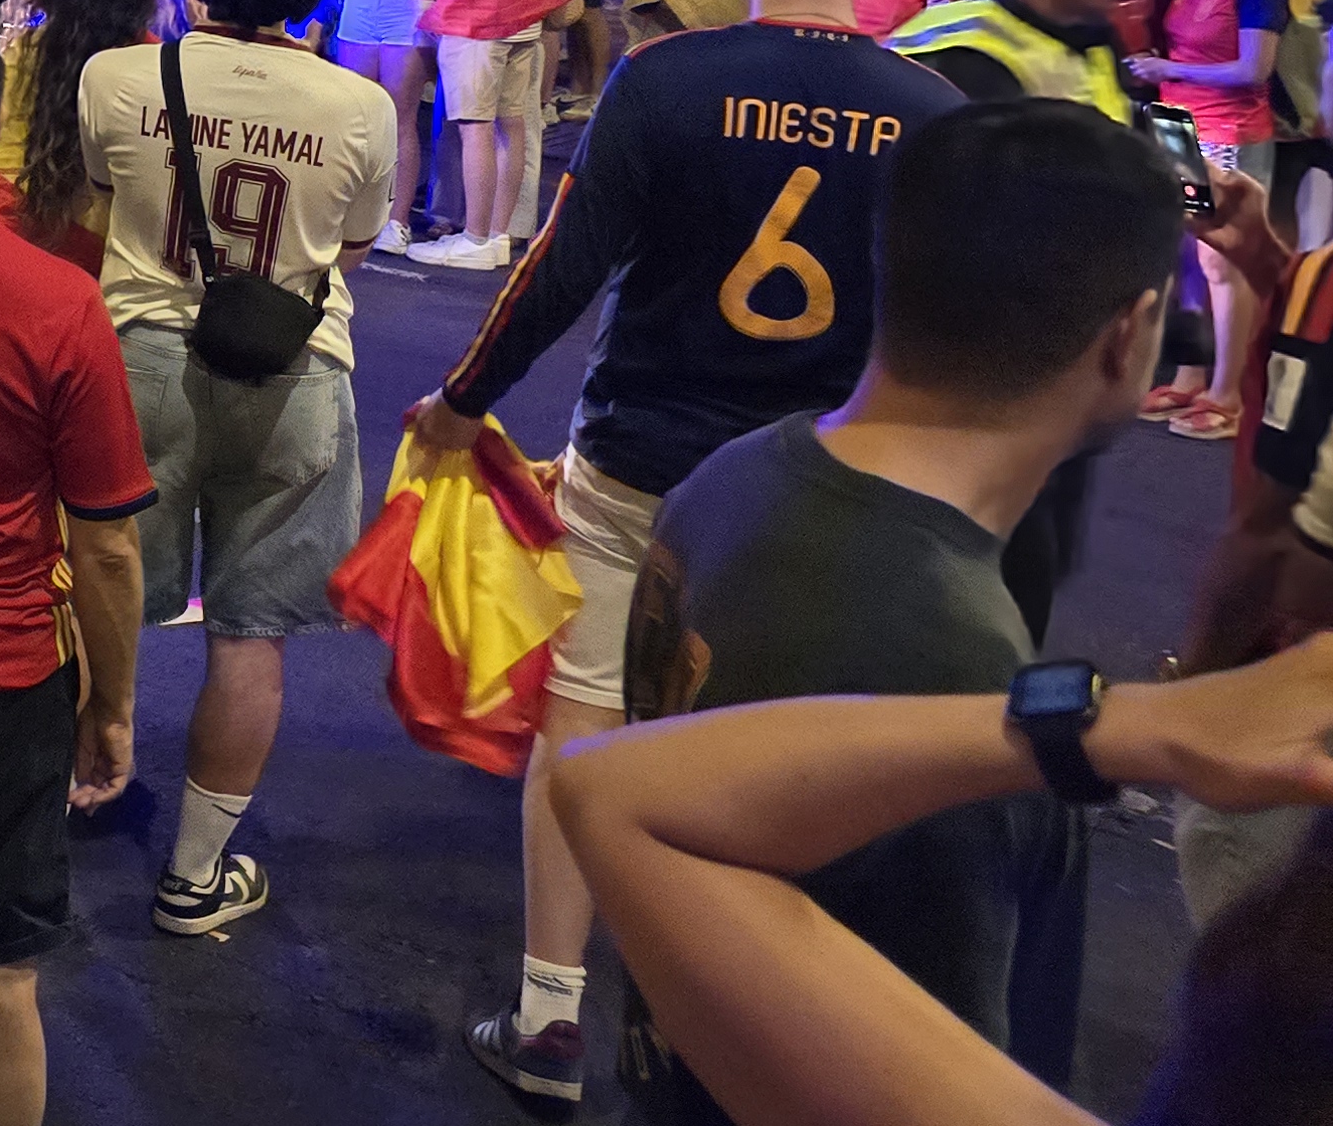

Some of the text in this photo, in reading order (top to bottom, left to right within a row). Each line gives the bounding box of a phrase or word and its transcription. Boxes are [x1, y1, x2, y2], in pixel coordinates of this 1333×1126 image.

[241, 122, 324, 167] YAMAL
[161, 147, 291, 282] 19
[718, 166, 835, 341] 6
